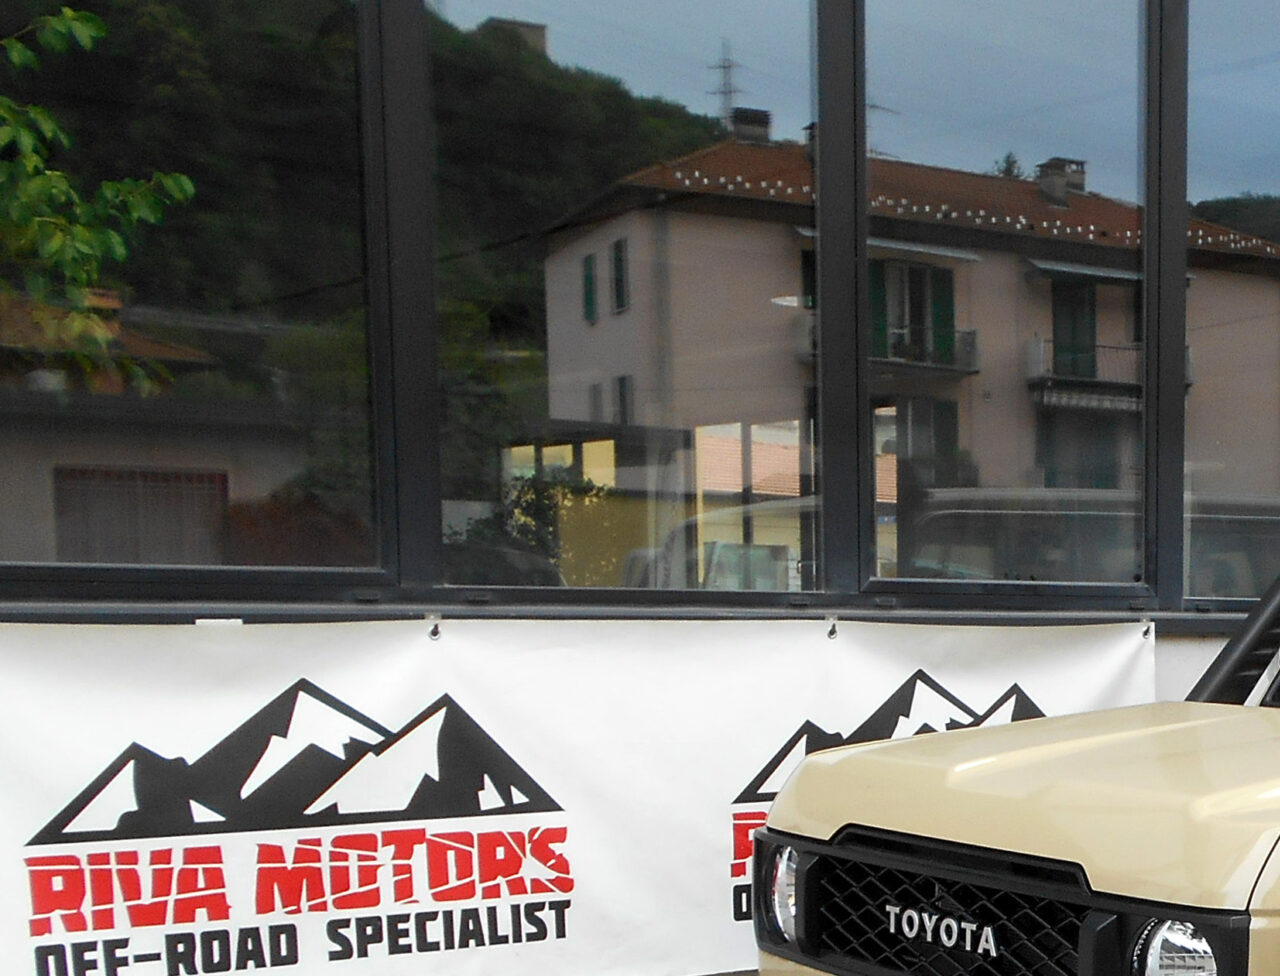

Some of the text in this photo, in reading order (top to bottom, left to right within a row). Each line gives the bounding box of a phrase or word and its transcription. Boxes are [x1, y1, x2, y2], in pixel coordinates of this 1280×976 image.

[24, 827, 575, 937] RIVA MOTORS
[326, 899, 571, 962] SPECIALIST
[885, 904, 997, 957] TOYOTA
